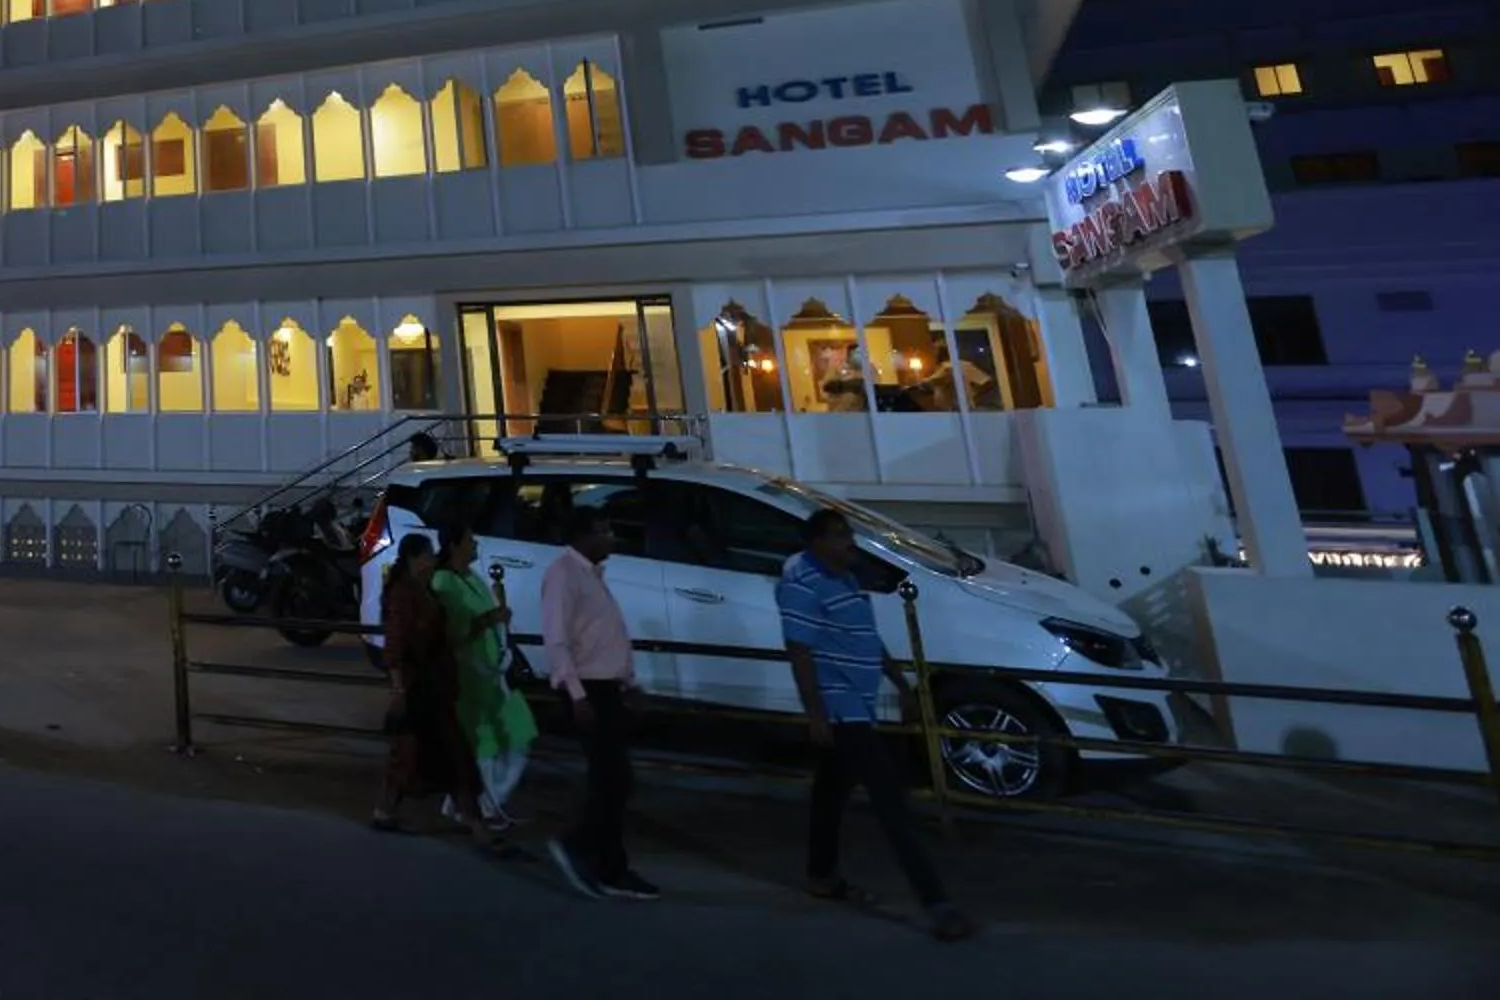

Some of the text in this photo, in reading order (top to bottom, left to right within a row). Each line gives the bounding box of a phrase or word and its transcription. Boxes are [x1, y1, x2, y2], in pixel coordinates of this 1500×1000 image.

[736, 70, 914, 108] HOTEL
[684, 103, 995, 159] SANGAM
[1065, 137, 1146, 205] HOTEL
[1052, 169, 1194, 270] SANGAM
